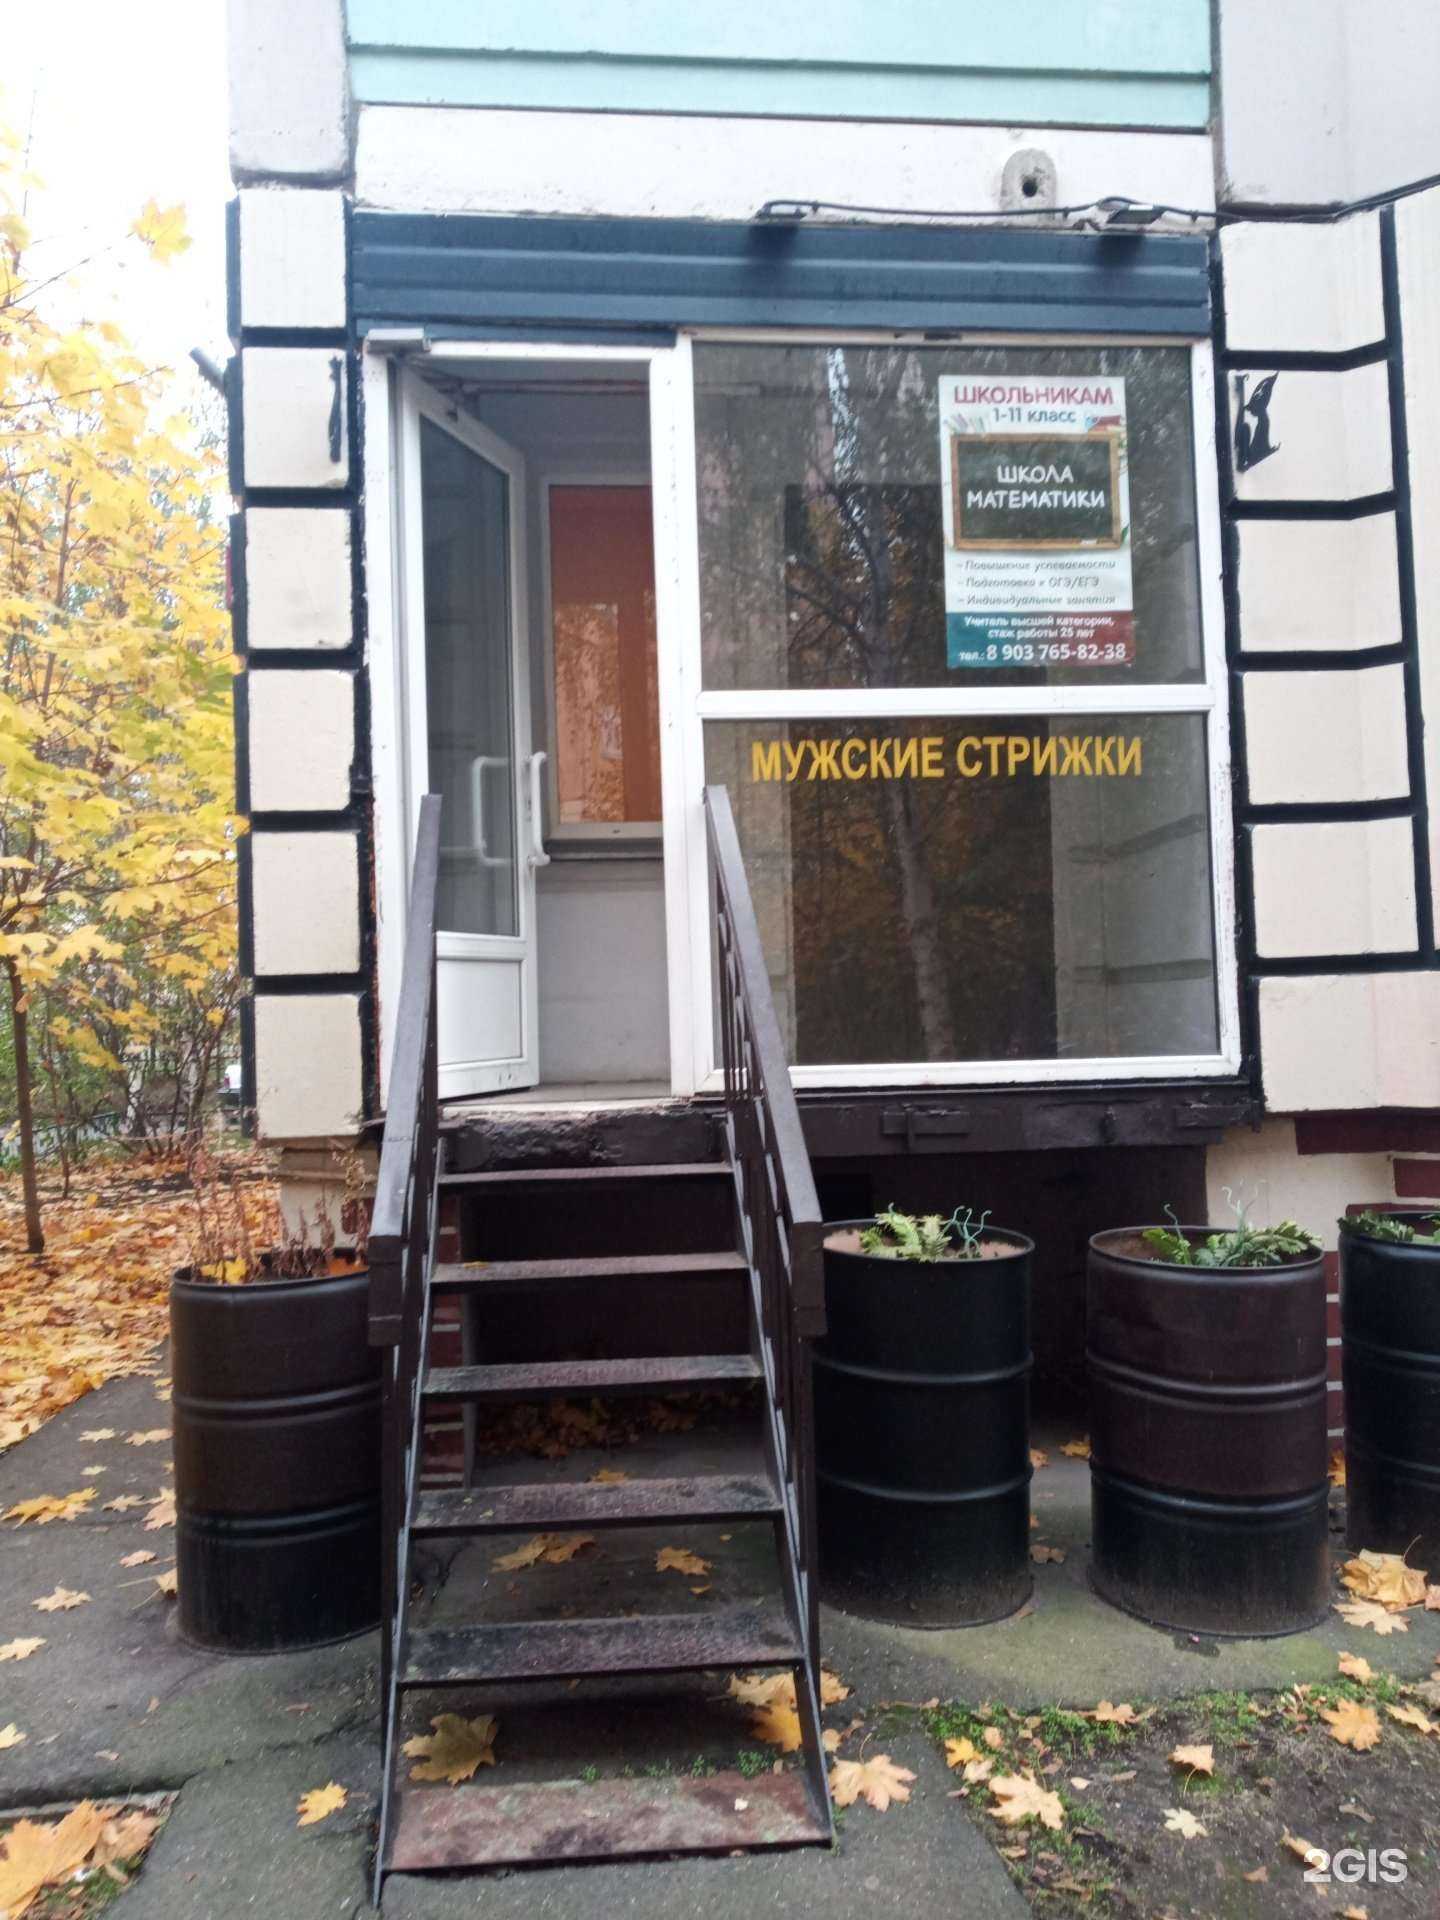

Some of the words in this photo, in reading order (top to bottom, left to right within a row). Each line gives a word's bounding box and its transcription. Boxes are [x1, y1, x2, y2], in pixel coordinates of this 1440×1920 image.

[953, 385, 1114, 405] ШКОЛЬНИКАМ
[993, 407, 1022, 422] 1-11
[1027, 410, 1076, 424] класс
[996, 463, 1075, 484] ШКОЛА
[965, 489, 1106, 509] МАТЕМАТИКИ
[1016, 627, 1058, 640] работы
[1060, 626, 1074, 638] 25
[986, 643, 998, 661] 8
[1001, 643, 1035, 661] 903
[1038, 642, 1127, 661] 765-82-38
[751, 736, 945, 783] МУЖСКИЕ
[956, 735, 1143, 778] СТРИЖКИ
